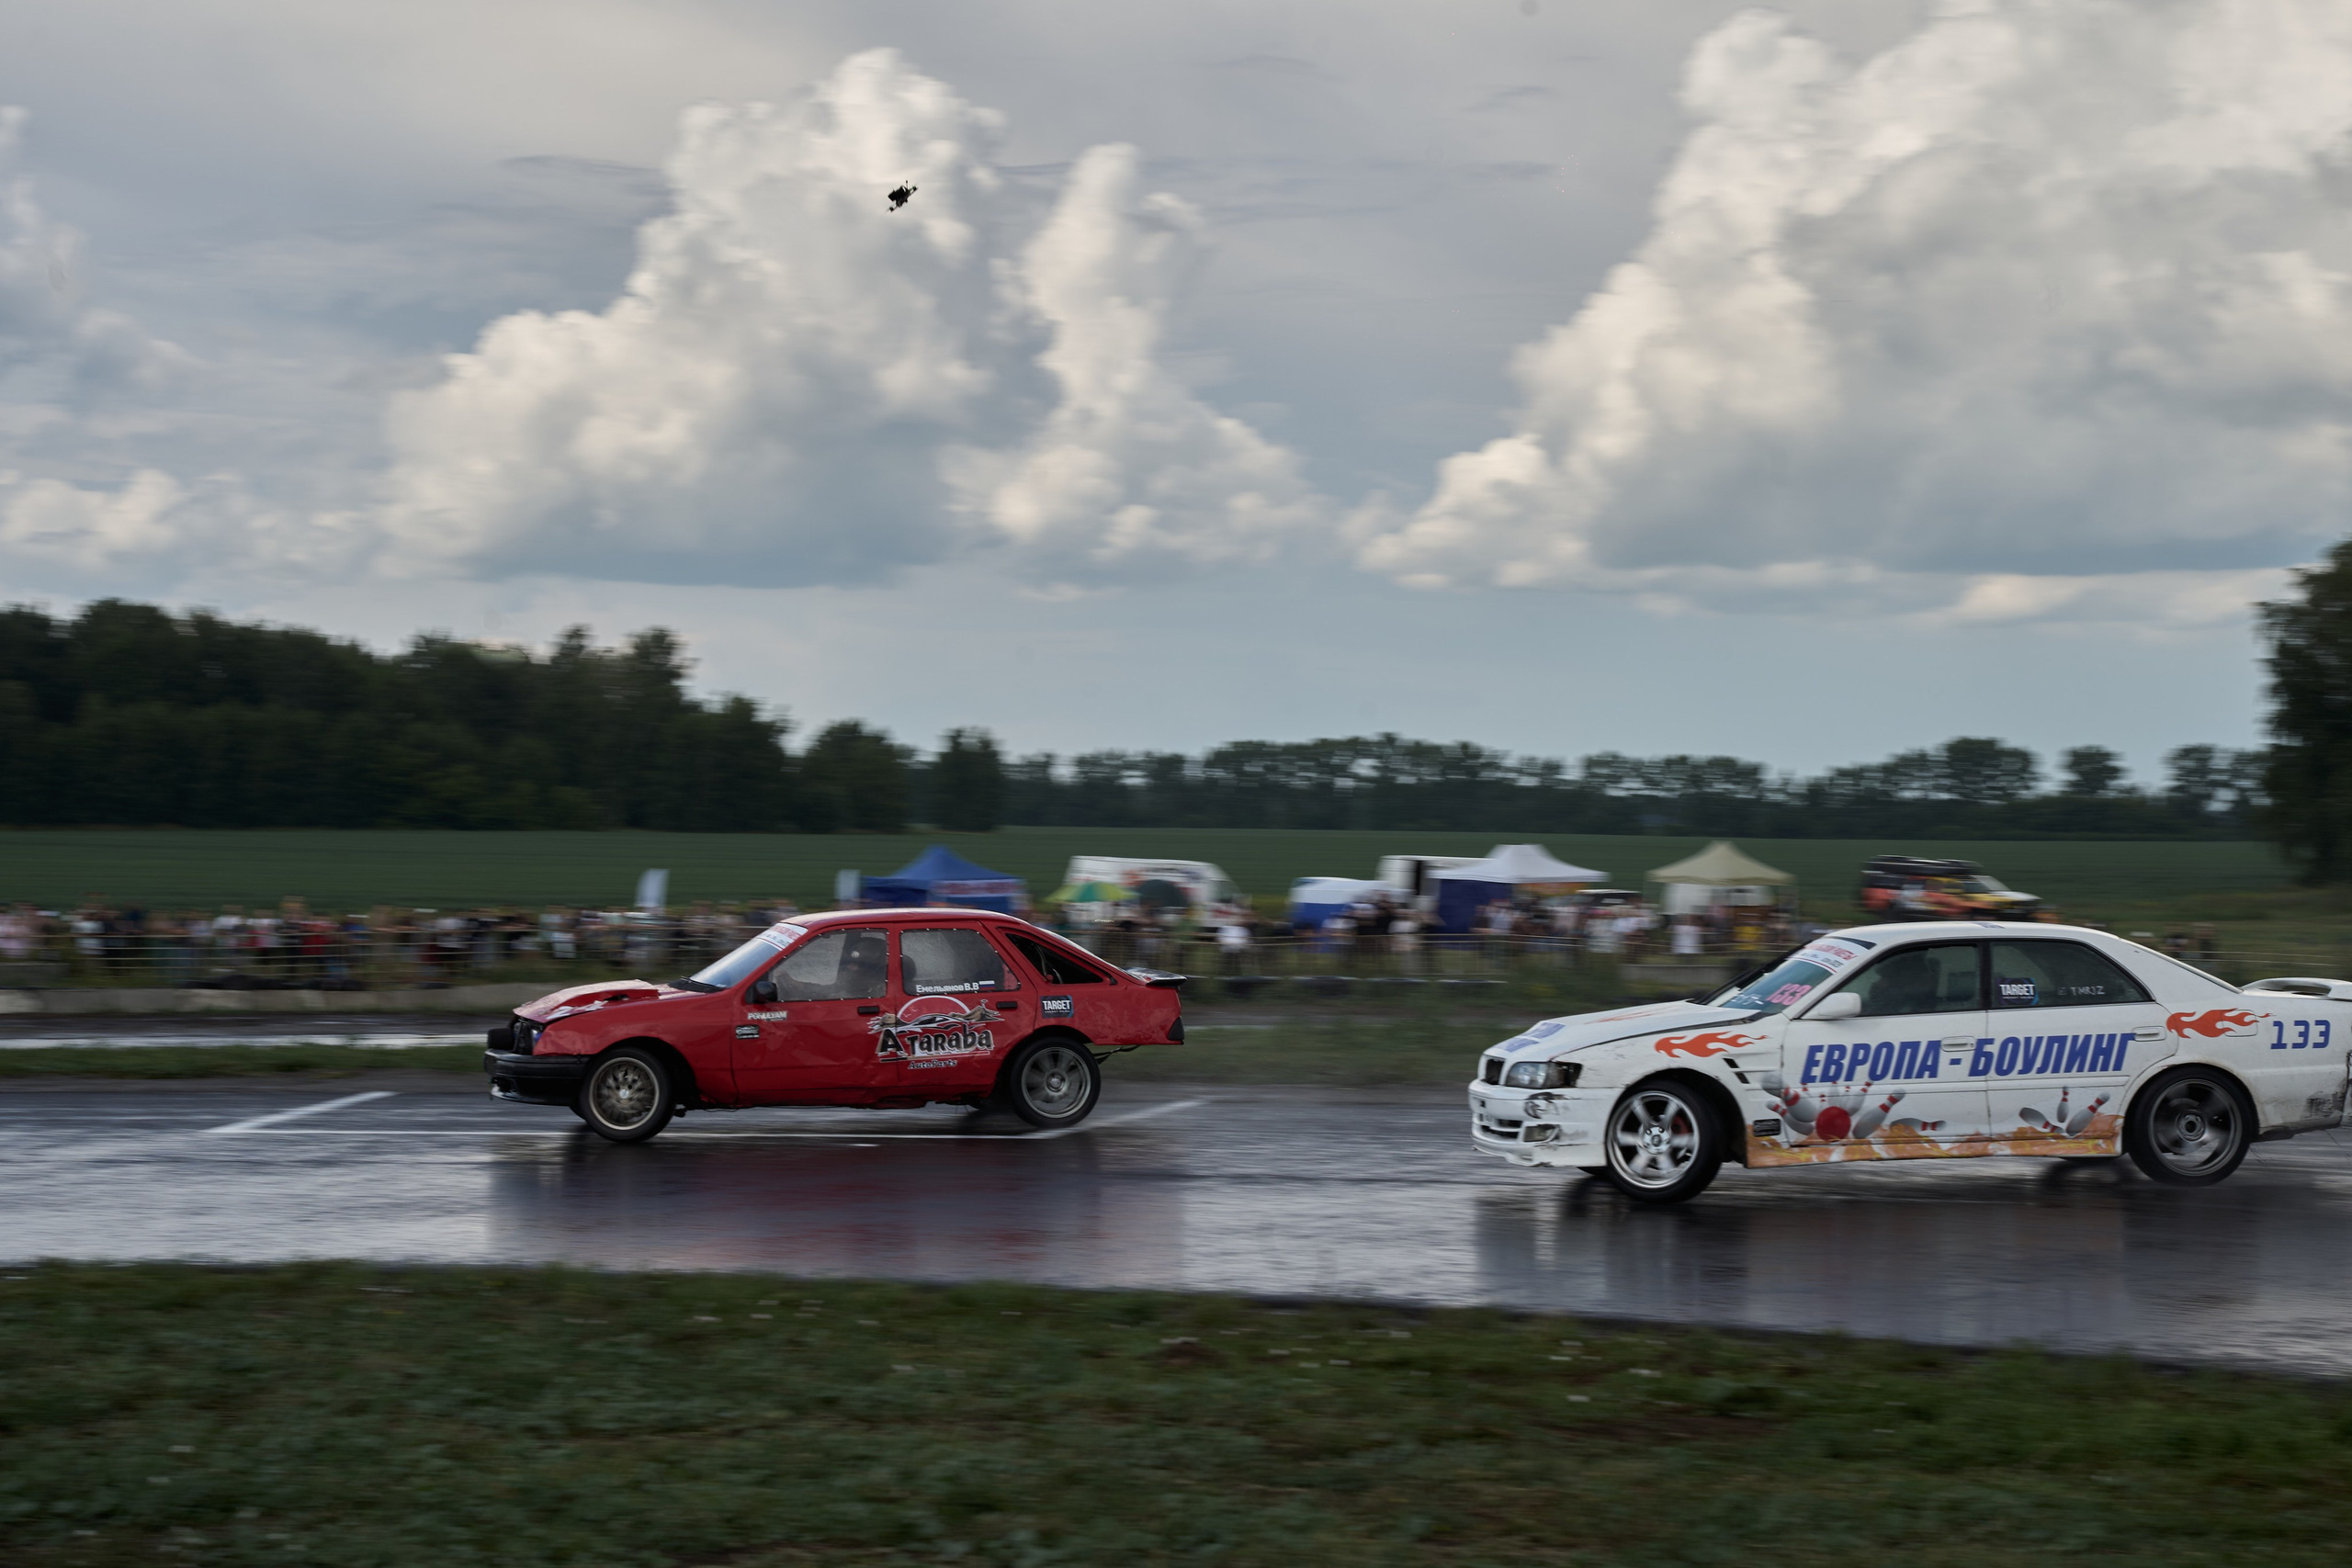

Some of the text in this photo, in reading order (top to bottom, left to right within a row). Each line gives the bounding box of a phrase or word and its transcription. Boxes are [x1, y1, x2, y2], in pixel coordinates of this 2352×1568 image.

[915, 983, 965, 993] Емельянов
[1999, 984, 2035, 996] TARGET
[1765, 983, 1813, 1006] 133
[1042, 999, 1071, 1010] TARGET
[2270, 1020, 2331, 1049] 133
[907, 1059, 958, 1069] AutoParts
[1800, 1040, 1942, 1084] ЕВРОПА
[1968, 1032, 2136, 1077] БОУЛИНГ
